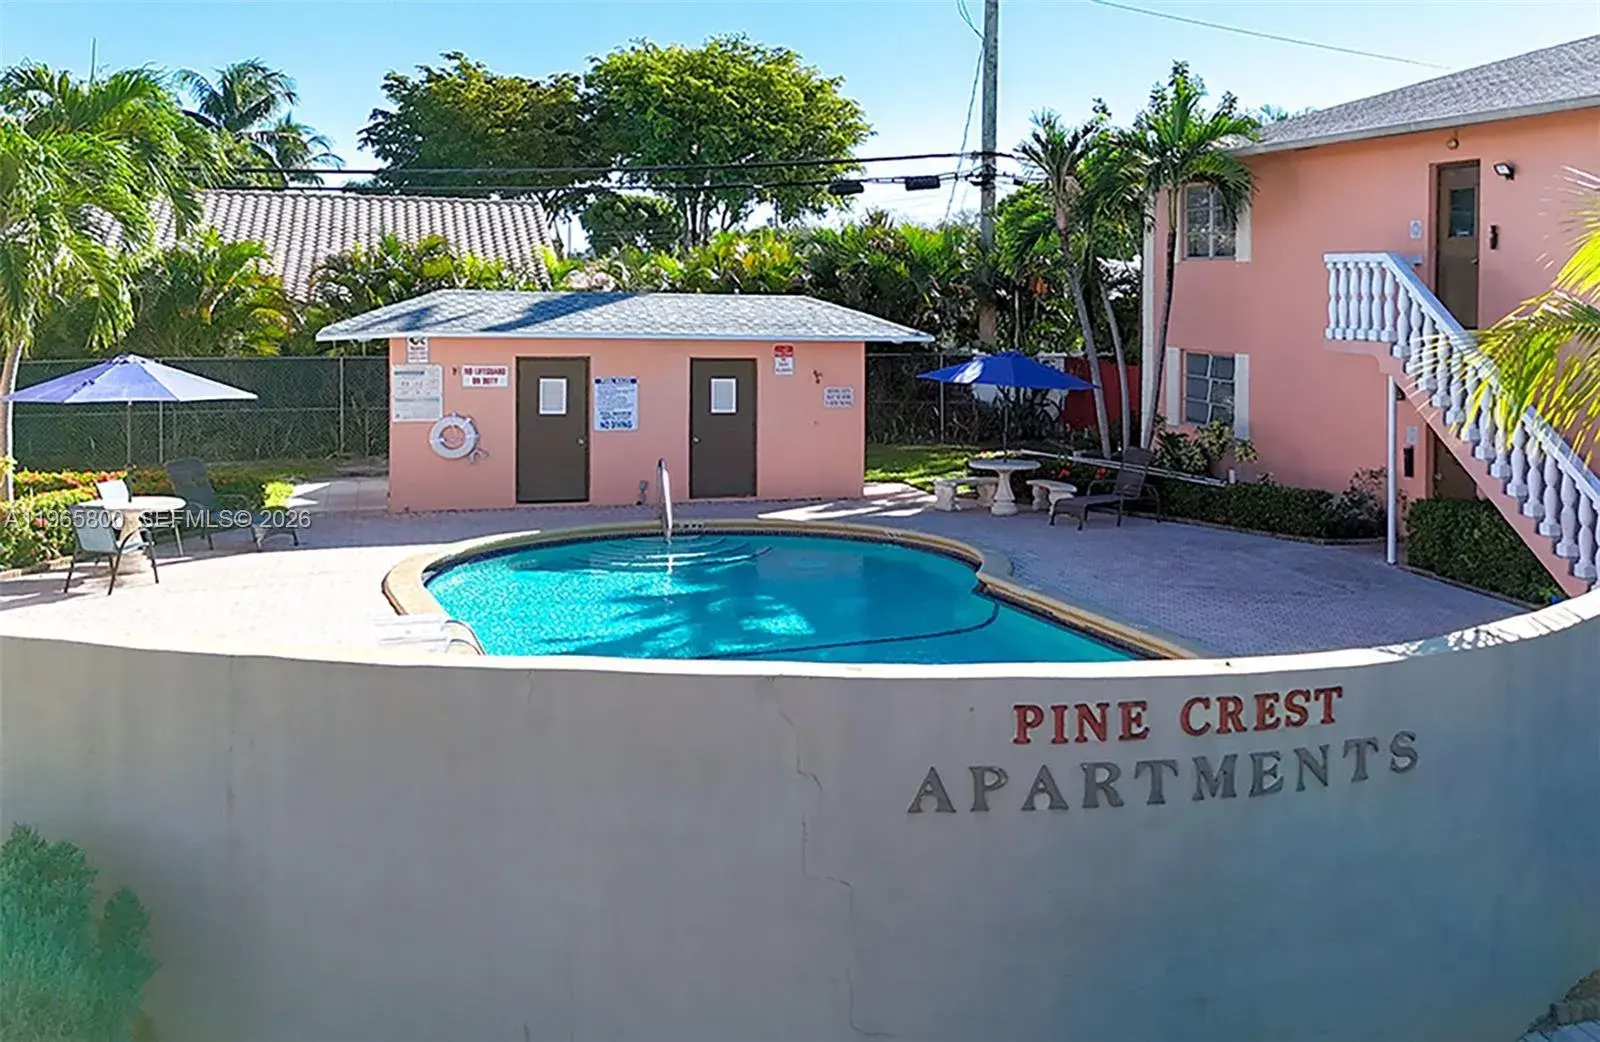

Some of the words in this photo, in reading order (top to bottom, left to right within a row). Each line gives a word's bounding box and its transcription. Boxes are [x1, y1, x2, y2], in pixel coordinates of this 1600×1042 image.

[1013, 701, 1151, 744] PINE
[1180, 685, 1344, 737] CREST
[906, 730, 1419, 814] APARTMENTS
